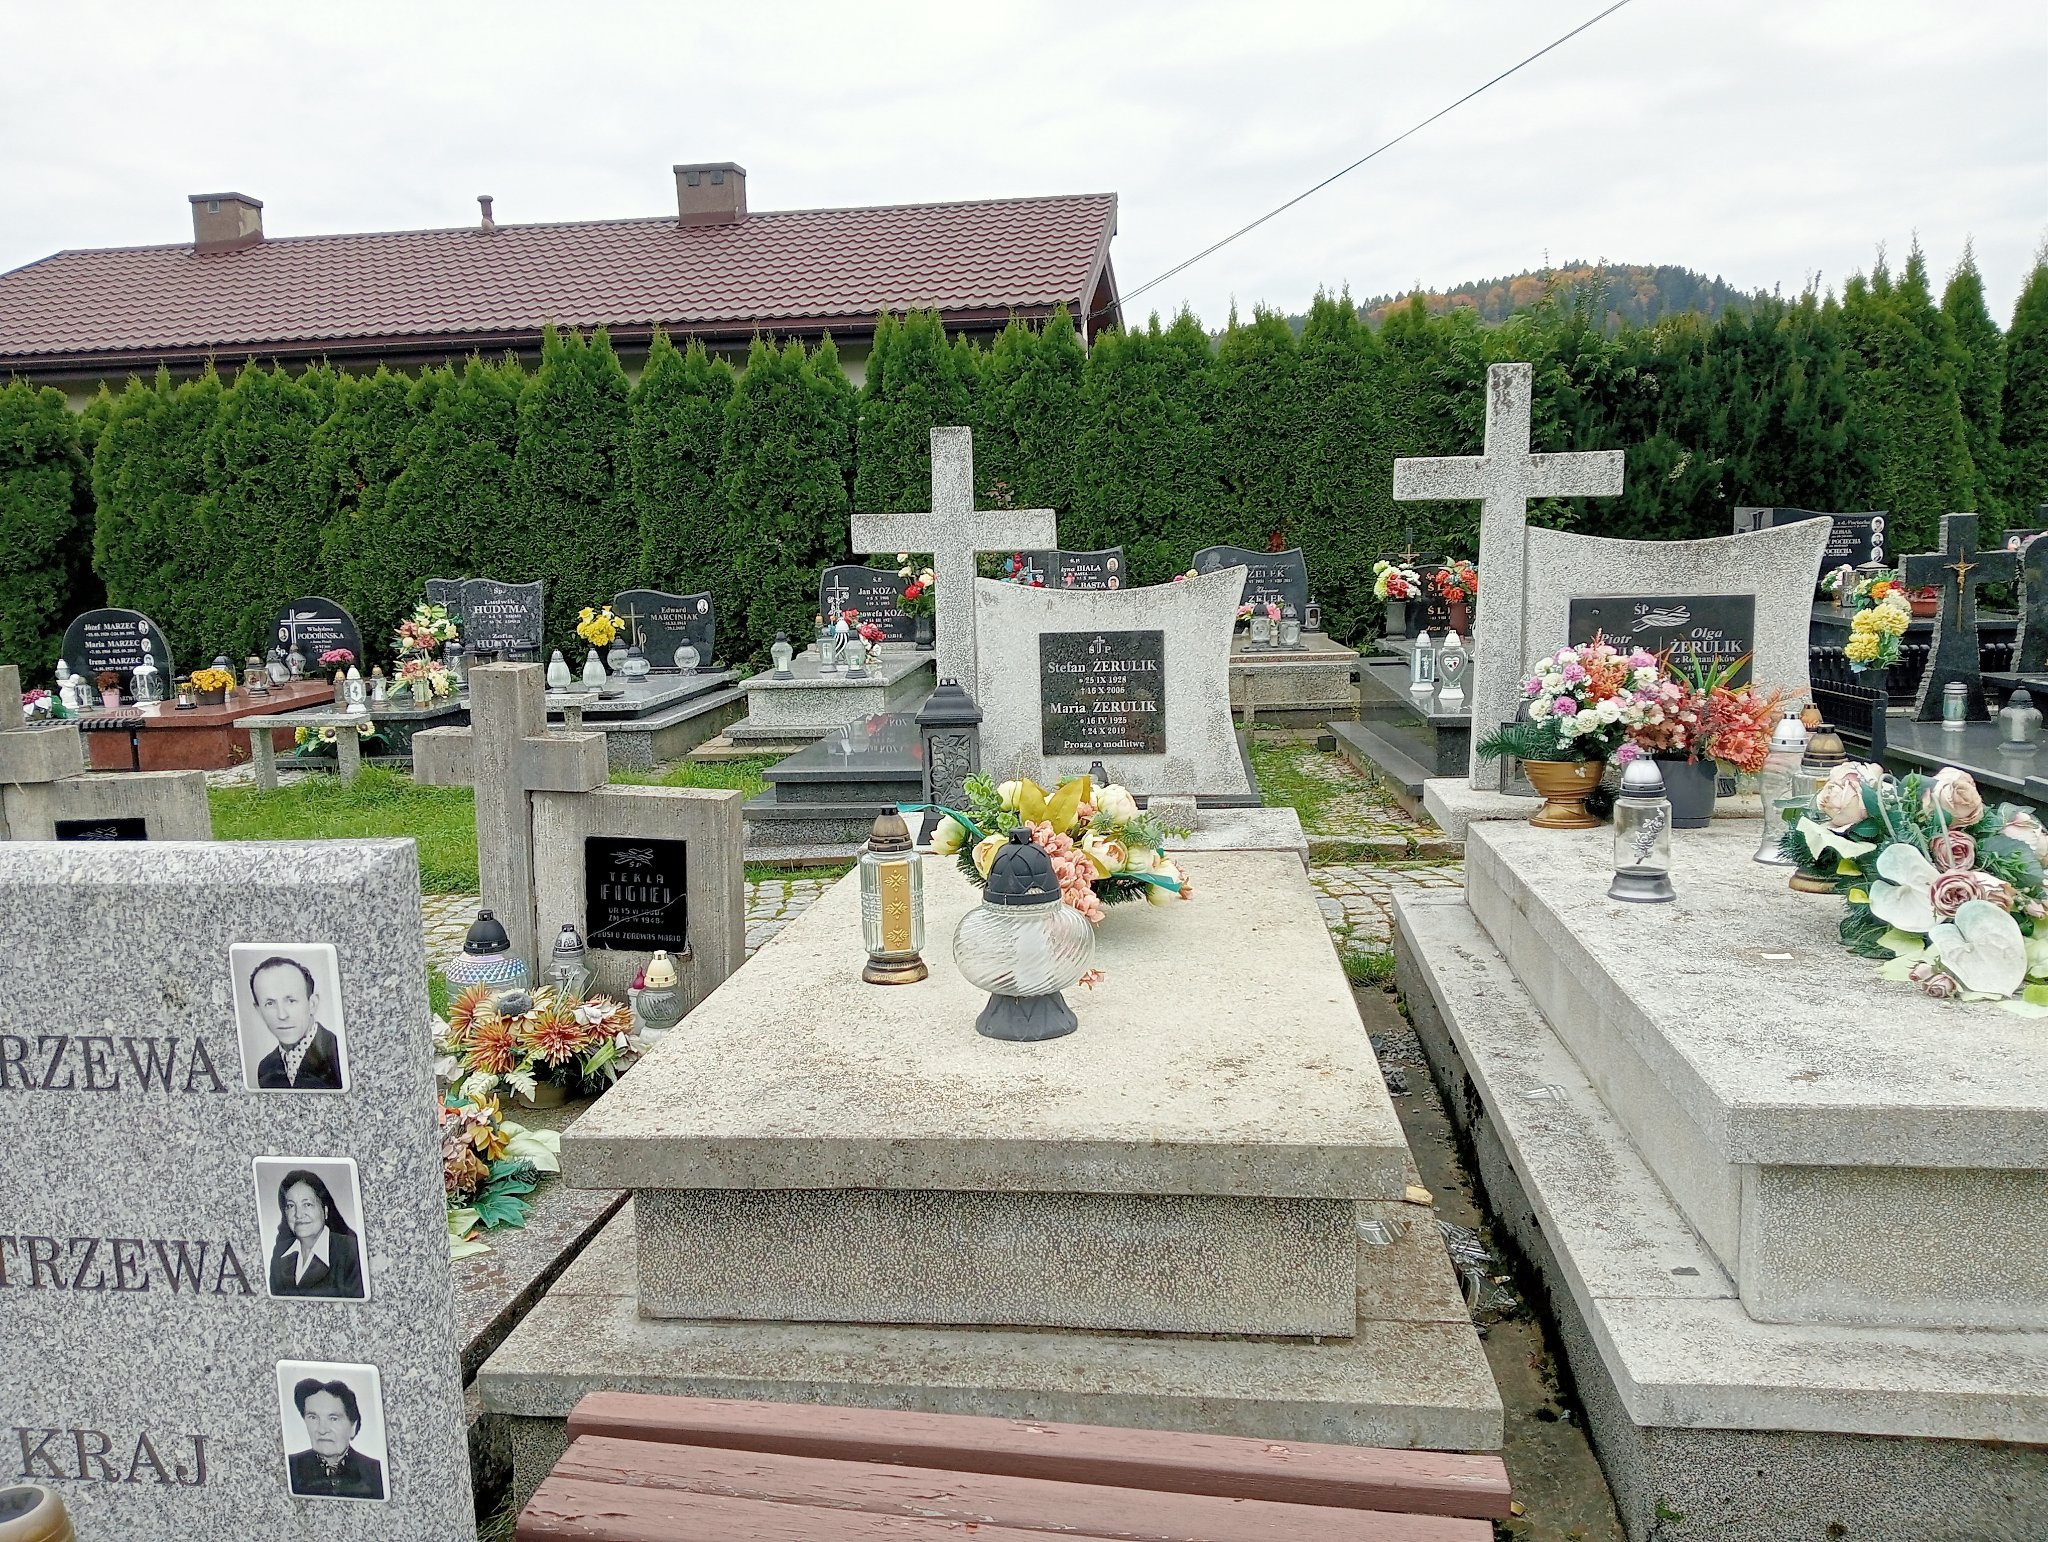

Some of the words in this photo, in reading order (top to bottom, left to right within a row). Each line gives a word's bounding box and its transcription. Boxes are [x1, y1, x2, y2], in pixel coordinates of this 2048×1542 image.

[872, 587, 898, 595] KOZA
[474, 604, 528, 614] HUDYMA
[661, 606, 687, 614] Edward
[650, 613, 699, 621] MARCINIAK
[103, 622, 136, 630] MARZEC
[1691, 627, 1723, 640] Olga
[1600, 633, 1633, 644] Piotr
[84, 641, 105, 649] Maria
[107, 640, 140, 648] MARZEC
[88, 658, 107, 666] Irena
[109, 657, 142, 665] MARZEC
[1047, 661, 1086, 673] Stefan
[1092, 658, 1158, 672] ŻERULIK
[1084, 676, 1095, 684] 25
[1097, 676, 1107, 684] IX
[1087, 687, 1097, 695] 16
[1050, 702, 1087, 714] Maria
[1092, 699, 1158, 713] ŻERULIK
[1087, 716, 1096, 725] 16
[1097, 716, 1107, 724] IV
[1109, 716, 1127, 724] 1925
[1087, 727, 1097, 735] 24
[1099, 727, 1106, 735] X
[1107, 727, 1126, 735] 2019
[609, 871, 664, 884] TEKLA
[0, 1035, 229, 1094] RZEWA
[11, 1426, 210, 1487] KRAJ
